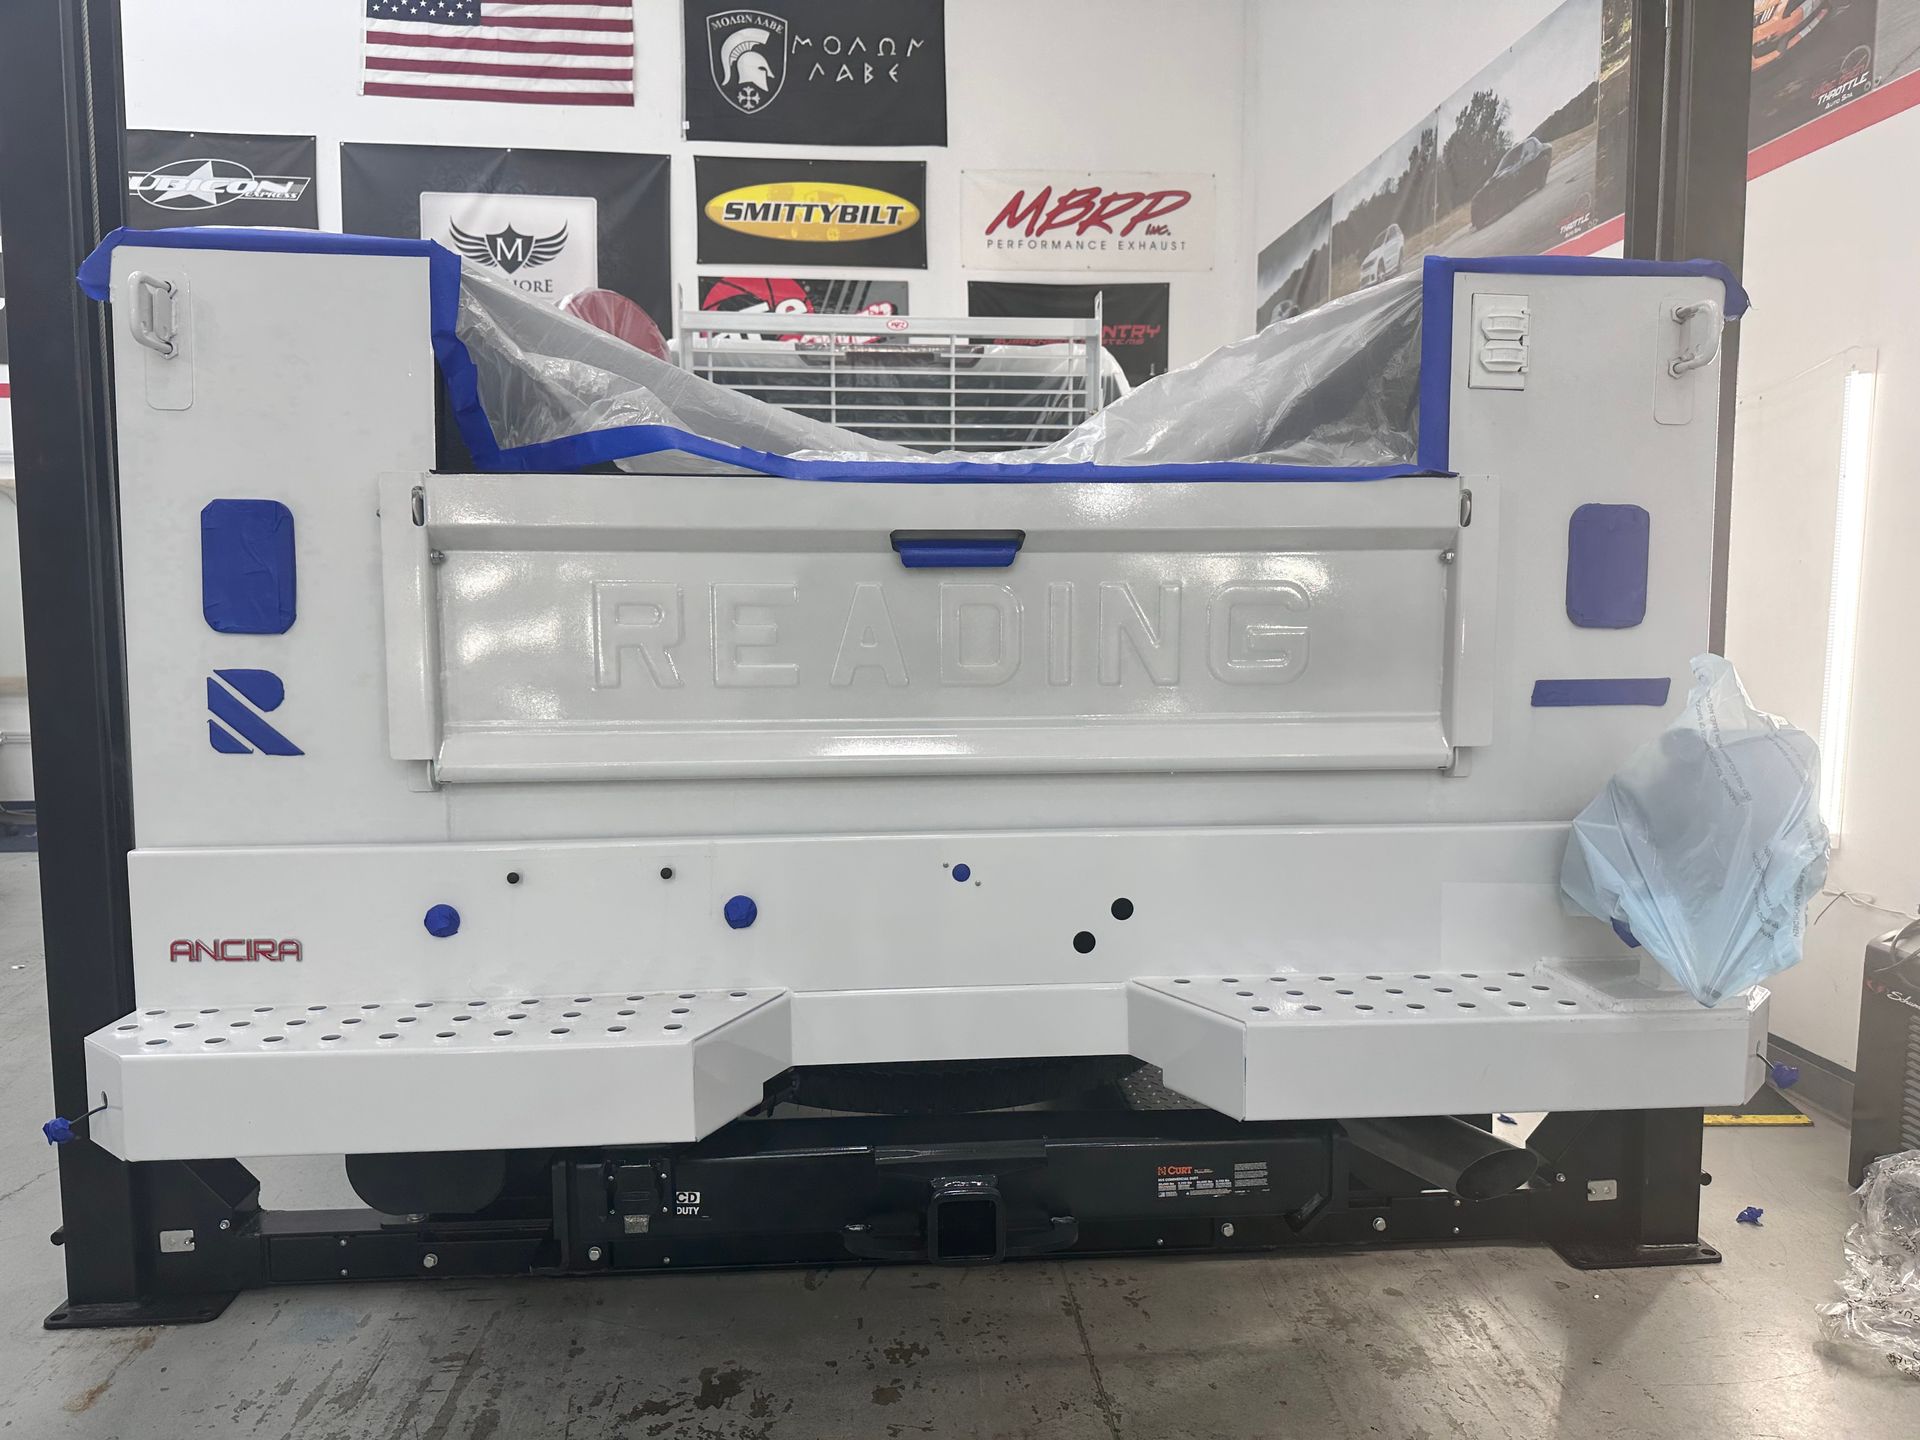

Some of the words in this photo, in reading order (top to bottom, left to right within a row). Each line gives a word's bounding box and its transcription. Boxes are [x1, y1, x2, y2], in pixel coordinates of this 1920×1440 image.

[1817, 71, 1869, 105] THROTTLE
[129, 175, 294, 194] UBICON
[724, 202, 904, 225] SMITTYBILT
[985, 186, 1192, 237] MBRP
[987, 240, 1107, 250] PERFORMANCE
[1118, 241, 1186, 250] EXHAUST
[1102, 324, 1161, 338] NTRY
[592, 580, 1311, 690] READING
[170, 939, 303, 962] ANCIRA
